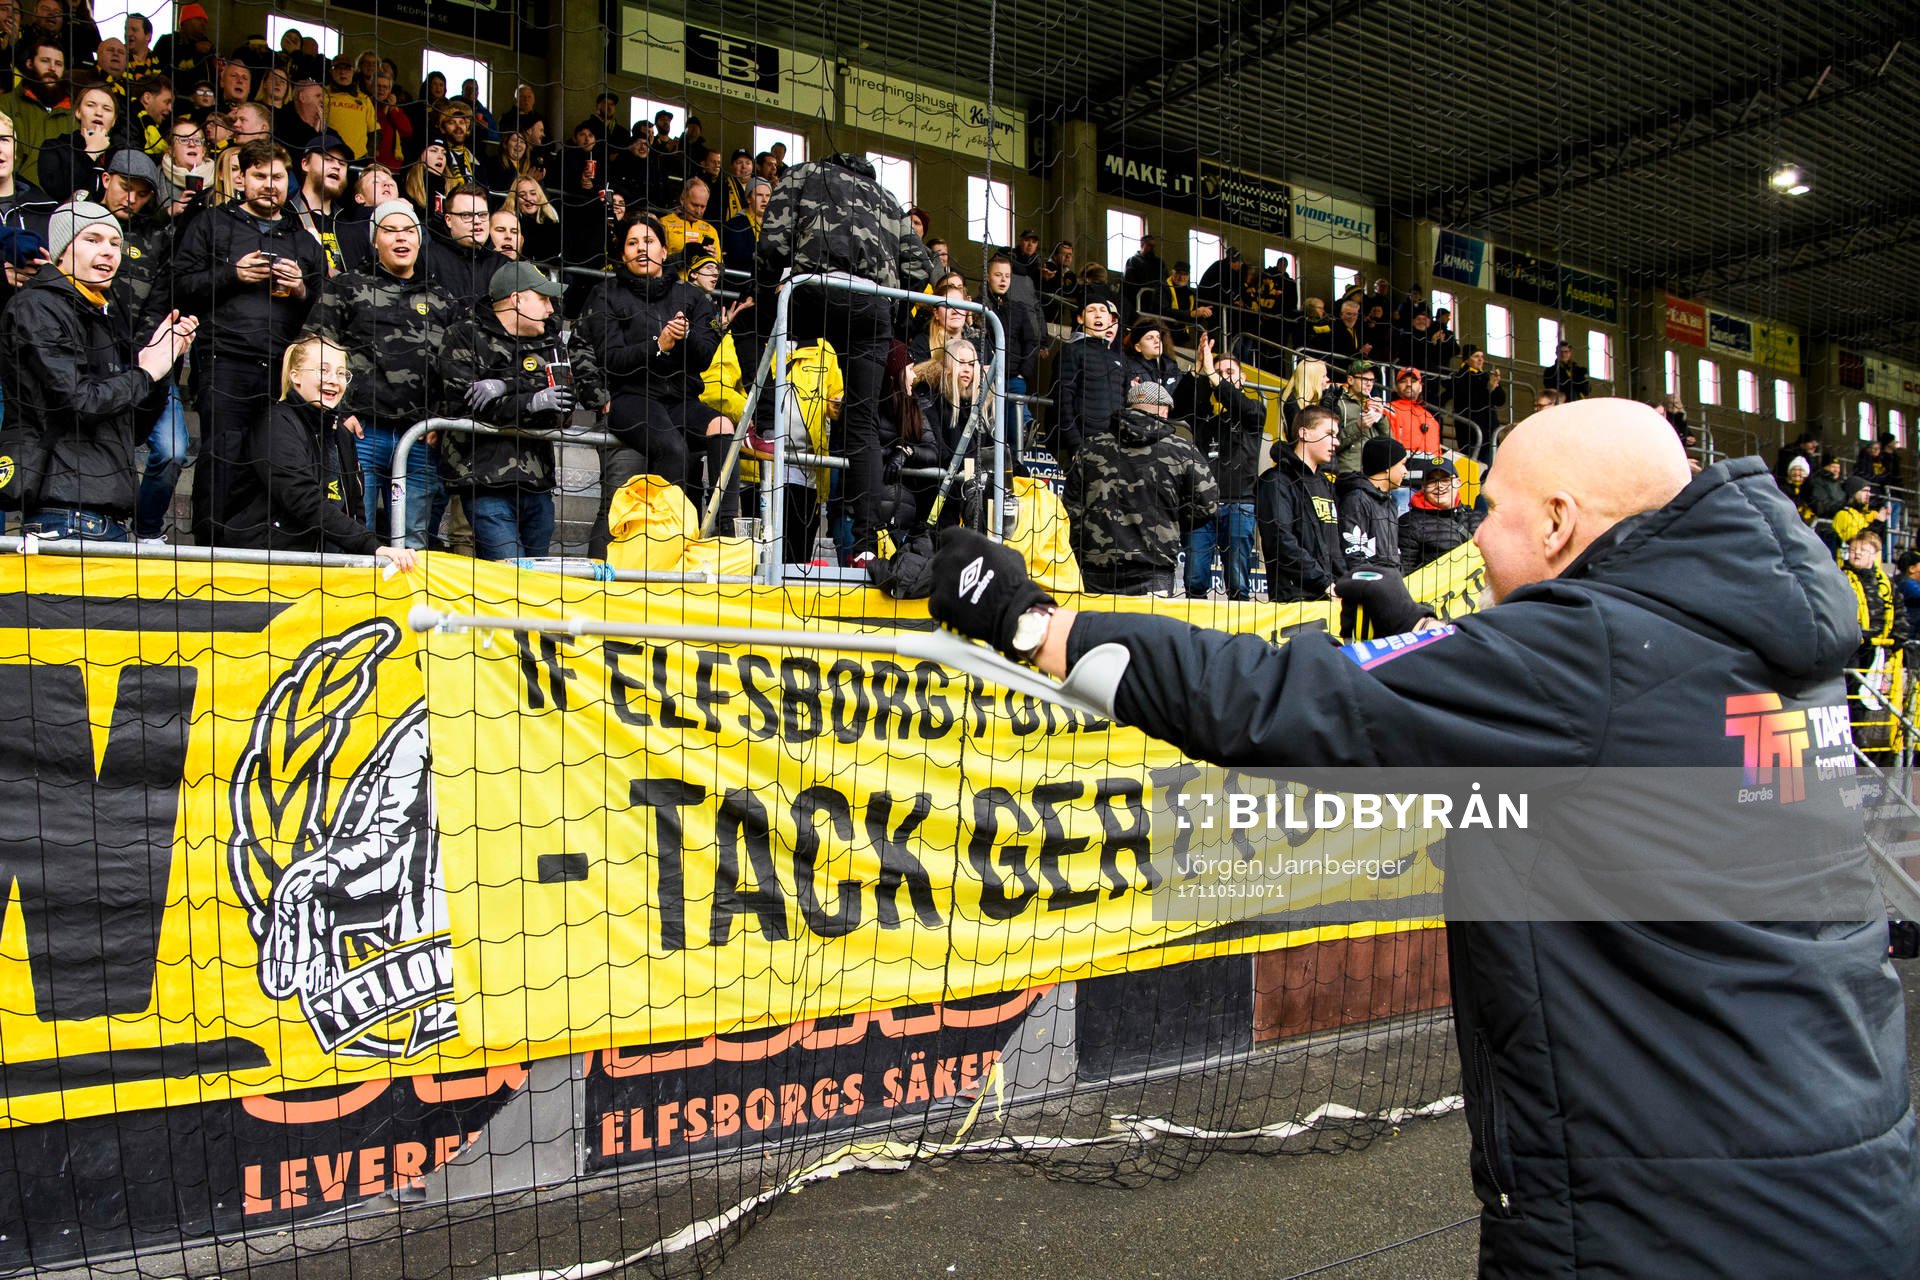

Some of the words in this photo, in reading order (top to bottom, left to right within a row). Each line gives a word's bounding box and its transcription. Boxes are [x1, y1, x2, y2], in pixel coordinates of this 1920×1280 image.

[684, 78, 739, 96] BOGSTEDT
[765, 98, 781, 106] AB
[849, 76, 959, 113] inredningshuset
[1105, 154, 1168, 188] MAKE
[1443, 253, 1475, 273] KPMG
[515, 630, 576, 711] IF
[603, 640, 955, 744] ELFSBORG
[1737, 787, 1773, 804] Borås
[629, 778, 944, 951] TACK
[967, 763, 1201, 921] GERT
[601, 1073, 865, 1157] ELFSBORGS
